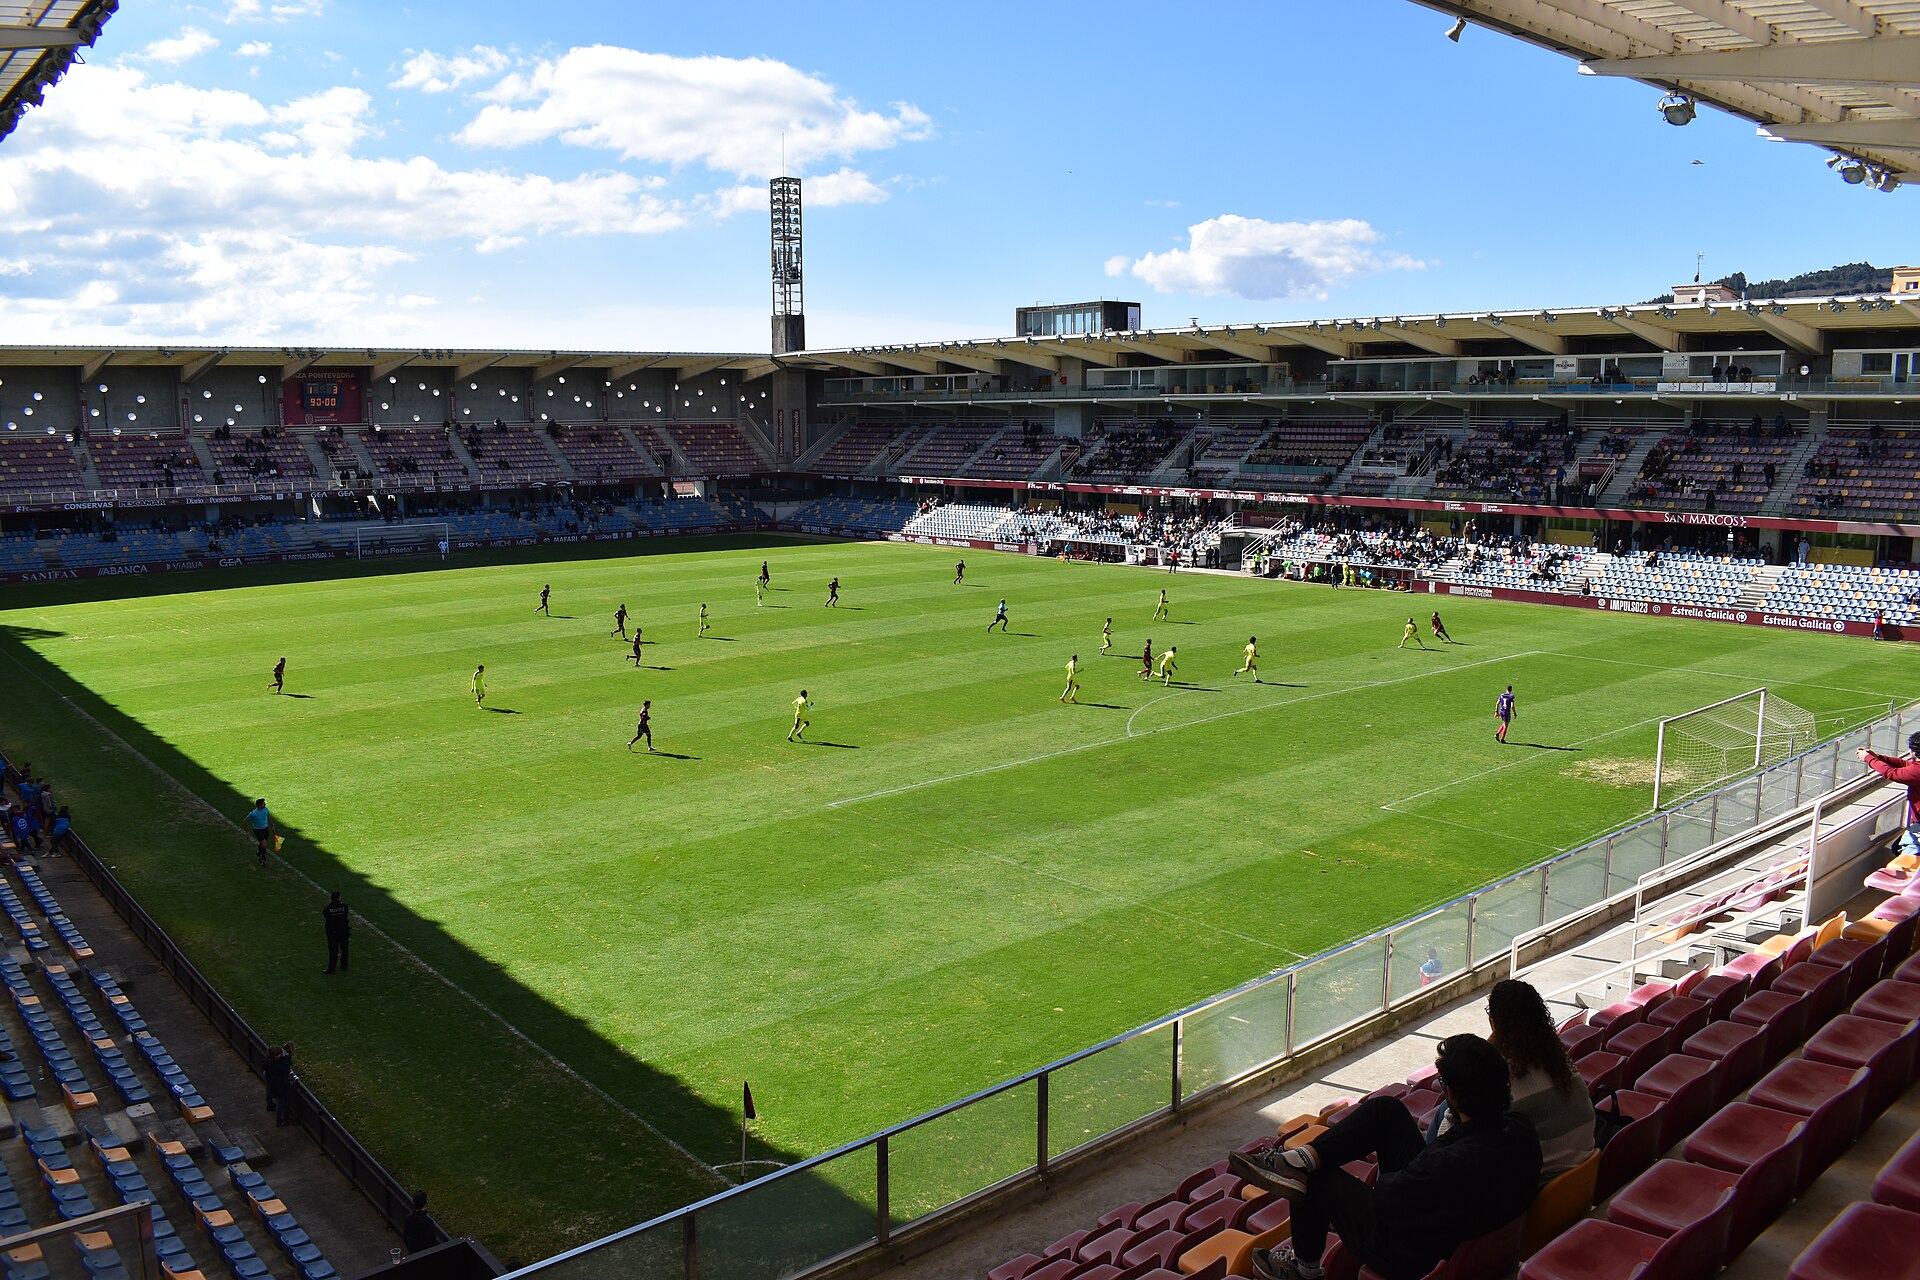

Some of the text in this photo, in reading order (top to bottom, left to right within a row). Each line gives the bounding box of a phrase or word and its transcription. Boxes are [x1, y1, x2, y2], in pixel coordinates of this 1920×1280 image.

[333, 386, 338, 394] 3
[310, 491, 328, 499] GEA
[337, 490, 355, 498] GEA
[379, 487, 416, 495] CELTAMOTOR
[186, 497, 204, 505] Diario
[209, 495, 242, 504] Pontevedra
[64, 501, 114, 511] CONSERVAS
[1689, 514, 1739, 527] MARCOS
[553, 535, 578, 544] MAFARI
[458, 541, 475, 549] SEPO
[362, 548, 374, 556] Hai
[375, 547, 389, 556] que
[173, 560, 204, 571] VIAQUA
[218, 556, 244, 568] GEA
[22, 569, 79, 582] SANIFAX
[1609, 598, 1648, 614] IMPULSO23
[1671, 606, 1735, 621] Estrella Galicia
[1762, 615, 1829, 631] Estrella Galicia
